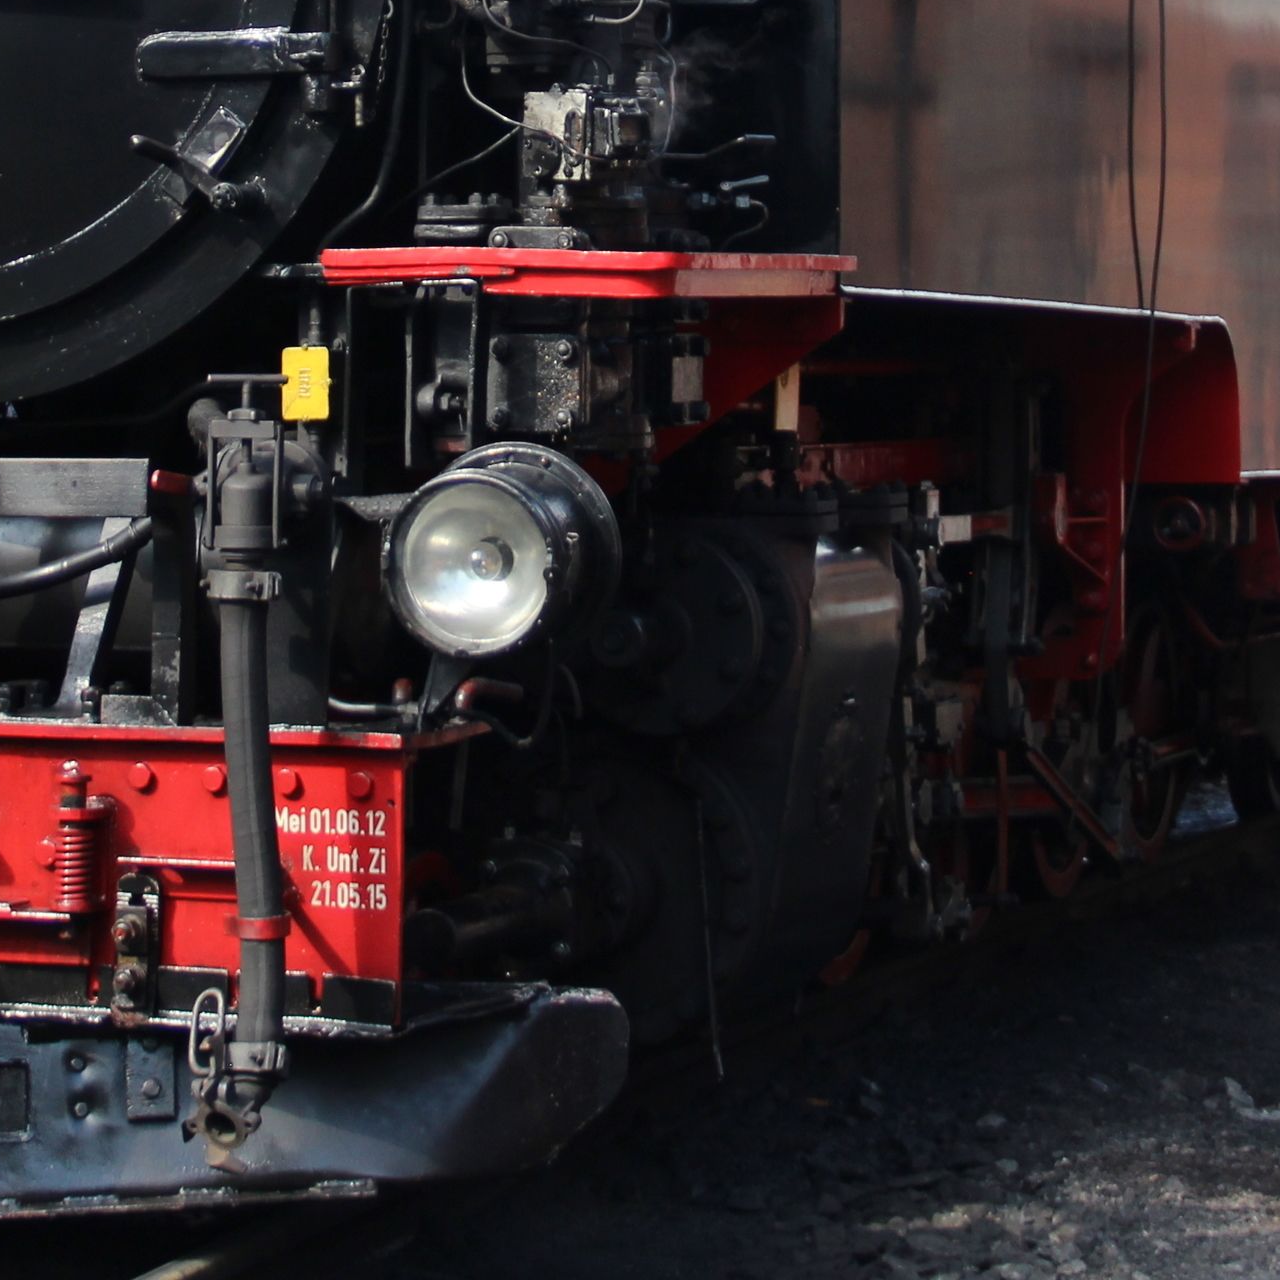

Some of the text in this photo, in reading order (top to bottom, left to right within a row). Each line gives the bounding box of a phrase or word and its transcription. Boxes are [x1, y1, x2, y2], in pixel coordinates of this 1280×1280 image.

[309, 807, 386, 837] 01.06.12
[302, 844, 387, 875] K. Unt. Zi
[310, 879, 388, 910] 21.05.15
